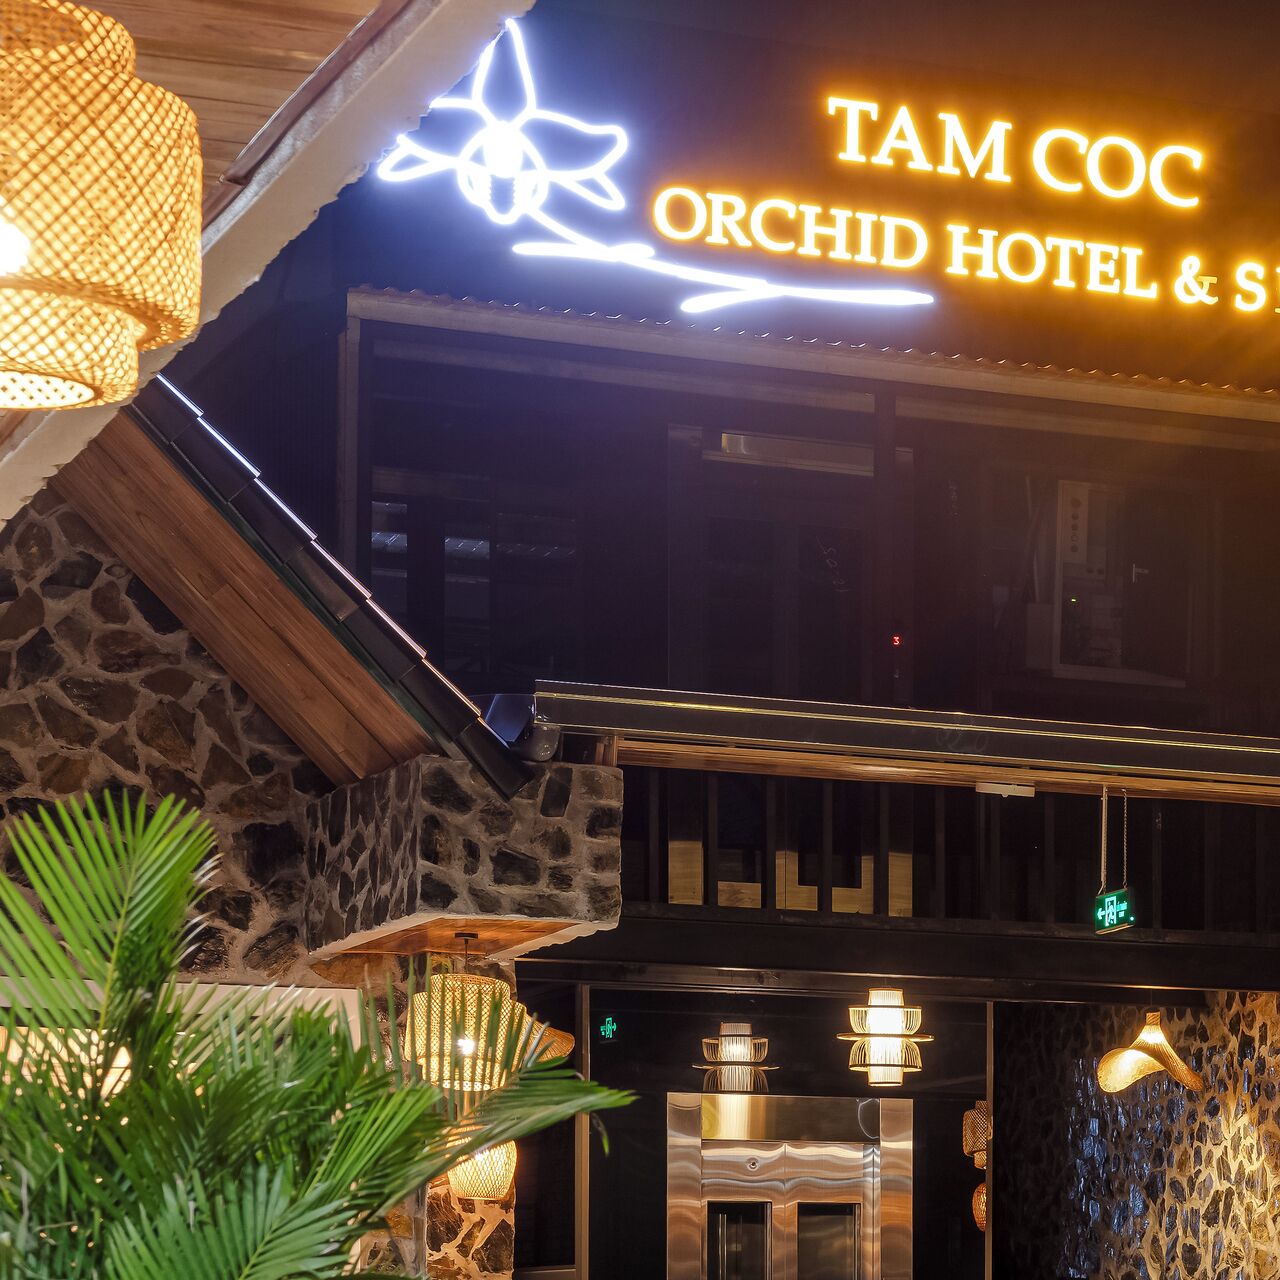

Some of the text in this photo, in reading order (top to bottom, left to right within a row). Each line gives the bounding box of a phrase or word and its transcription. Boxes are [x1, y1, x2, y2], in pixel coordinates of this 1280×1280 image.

[826, 95, 1205, 209] TAM COC
[652, 186, 930, 270] ORCHID
[945, 222, 1159, 301] HOTEL
[1172, 253, 1219, 306] &
